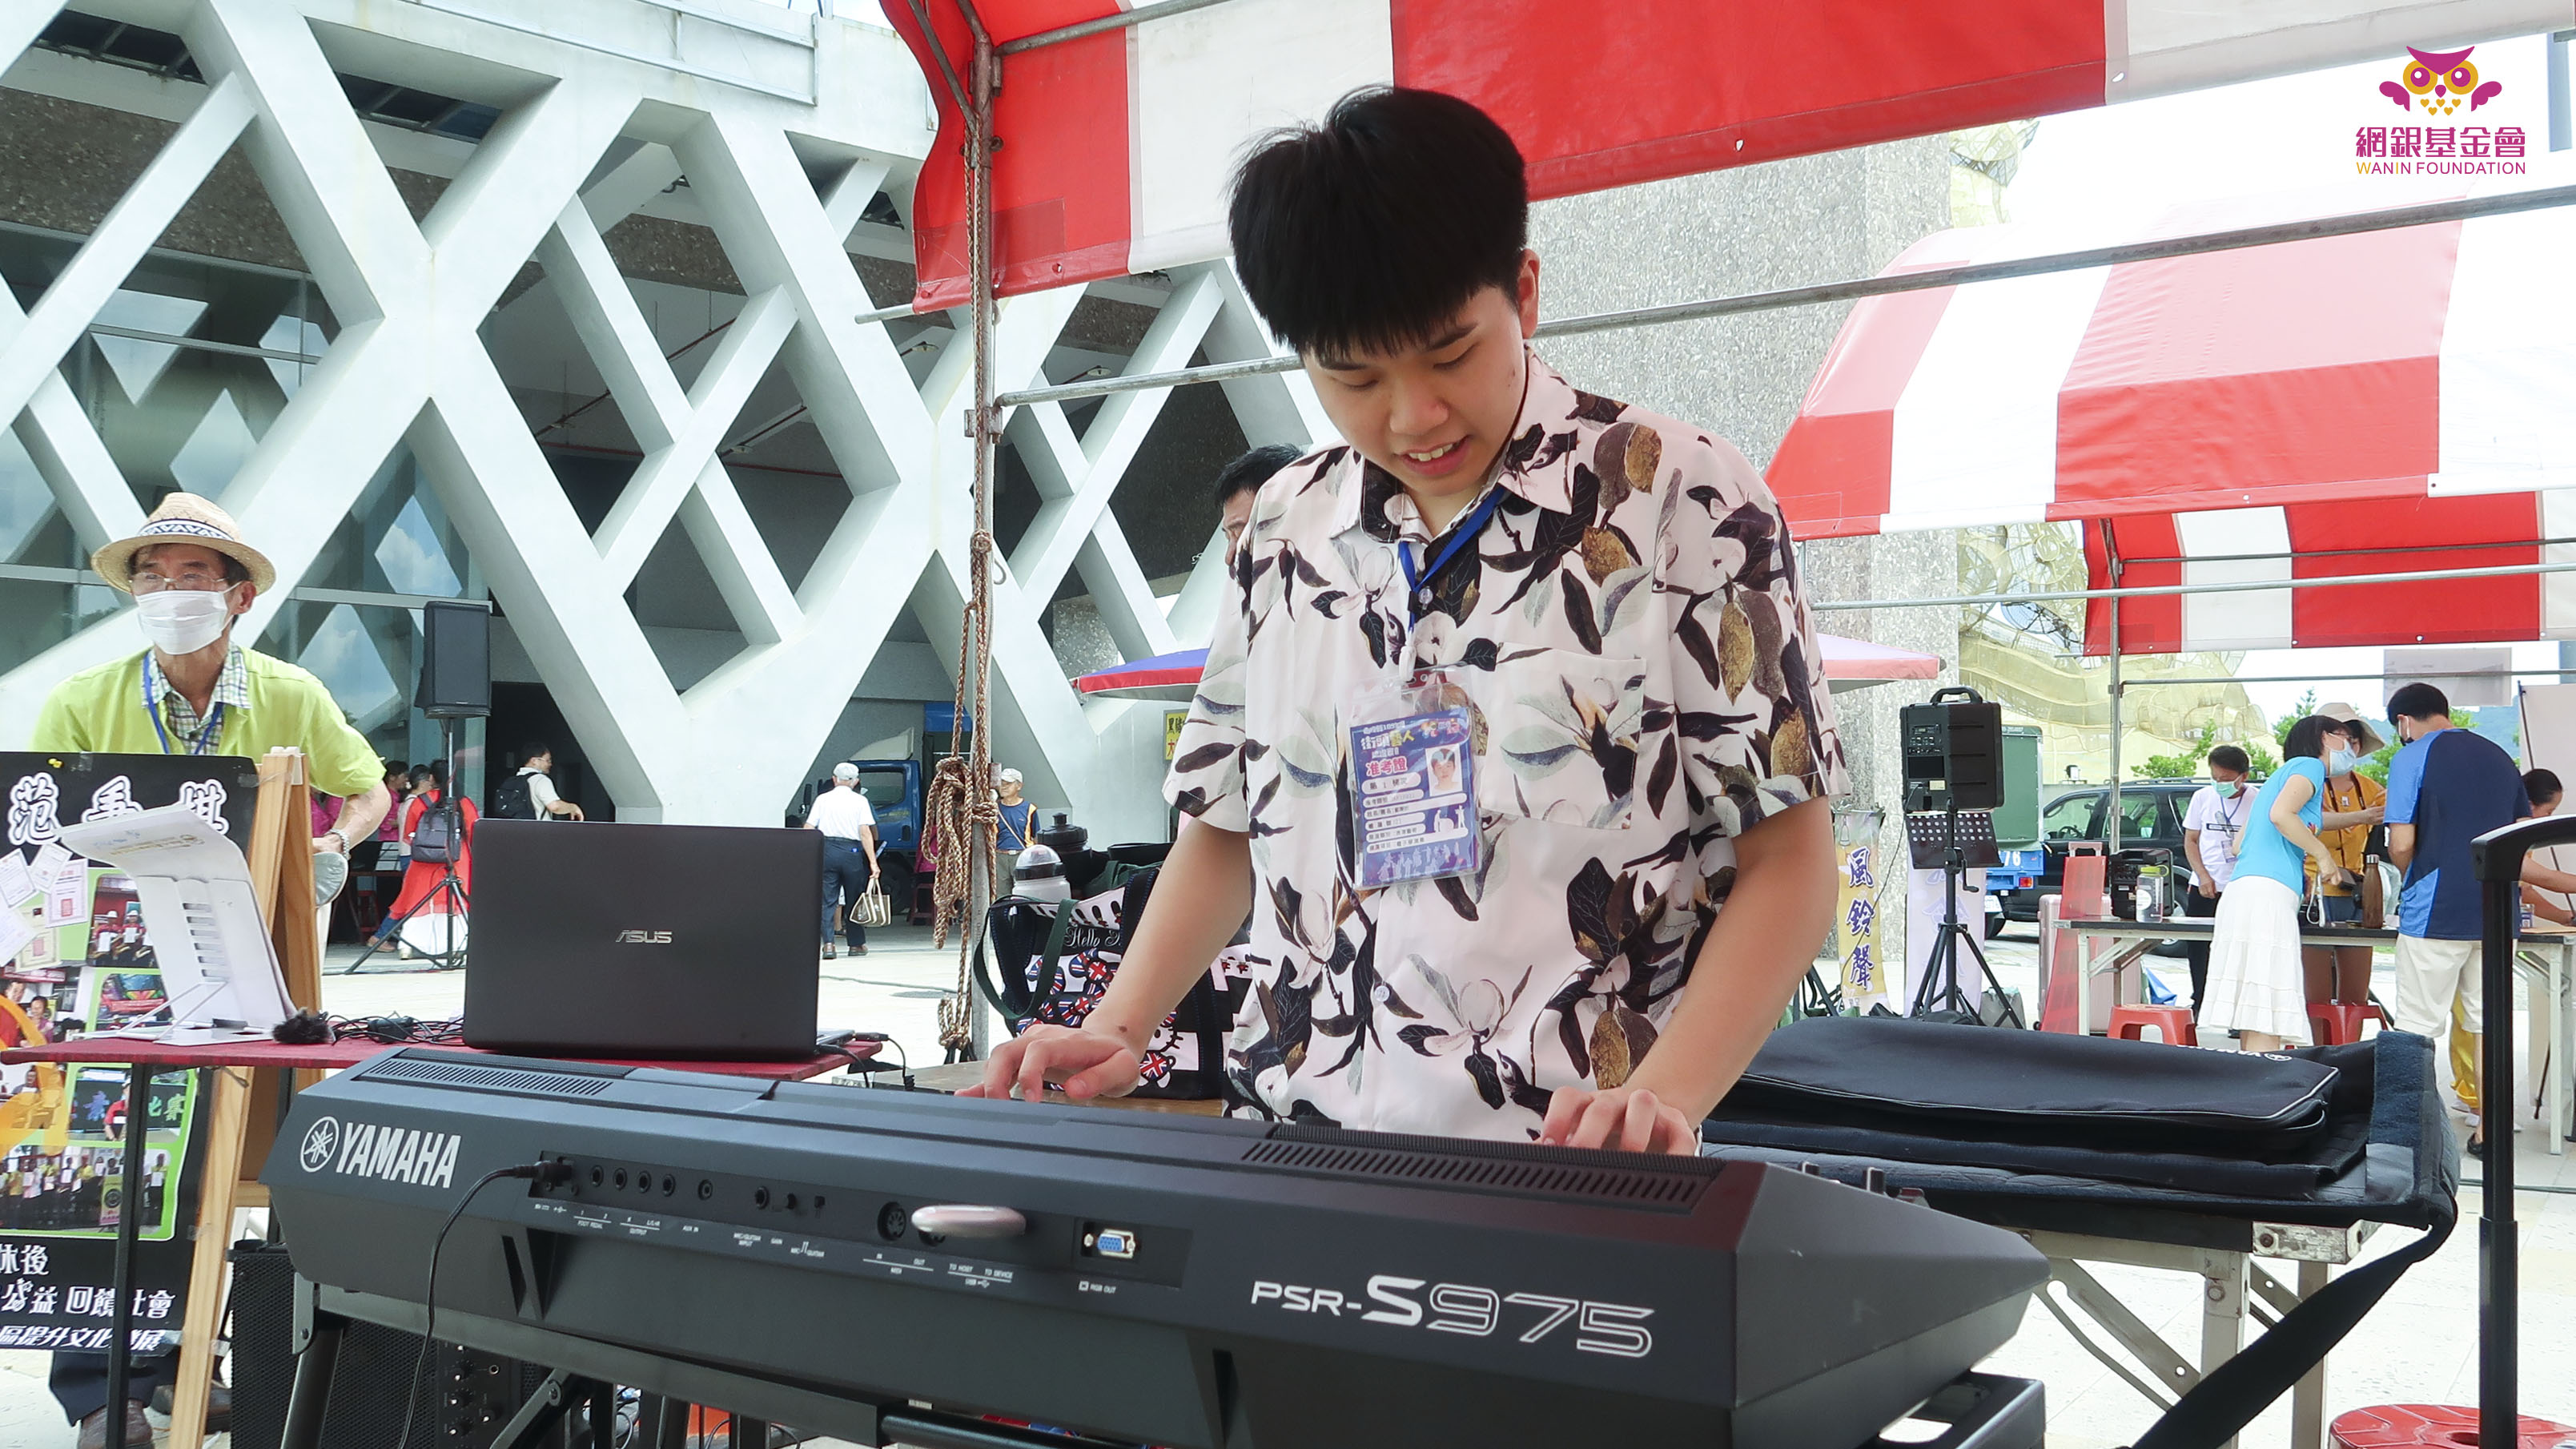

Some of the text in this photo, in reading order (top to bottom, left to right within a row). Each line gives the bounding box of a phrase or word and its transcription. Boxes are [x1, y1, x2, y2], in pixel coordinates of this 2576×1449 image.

[615, 930, 673, 944] ASUS
[1063, 927, 1101, 948] Hello
[1847, 846, 1875, 992] 風鈴聲
[336, 1122, 462, 1189] YAMAHA
[1251, 1274, 1655, 1358] PSR-S975
